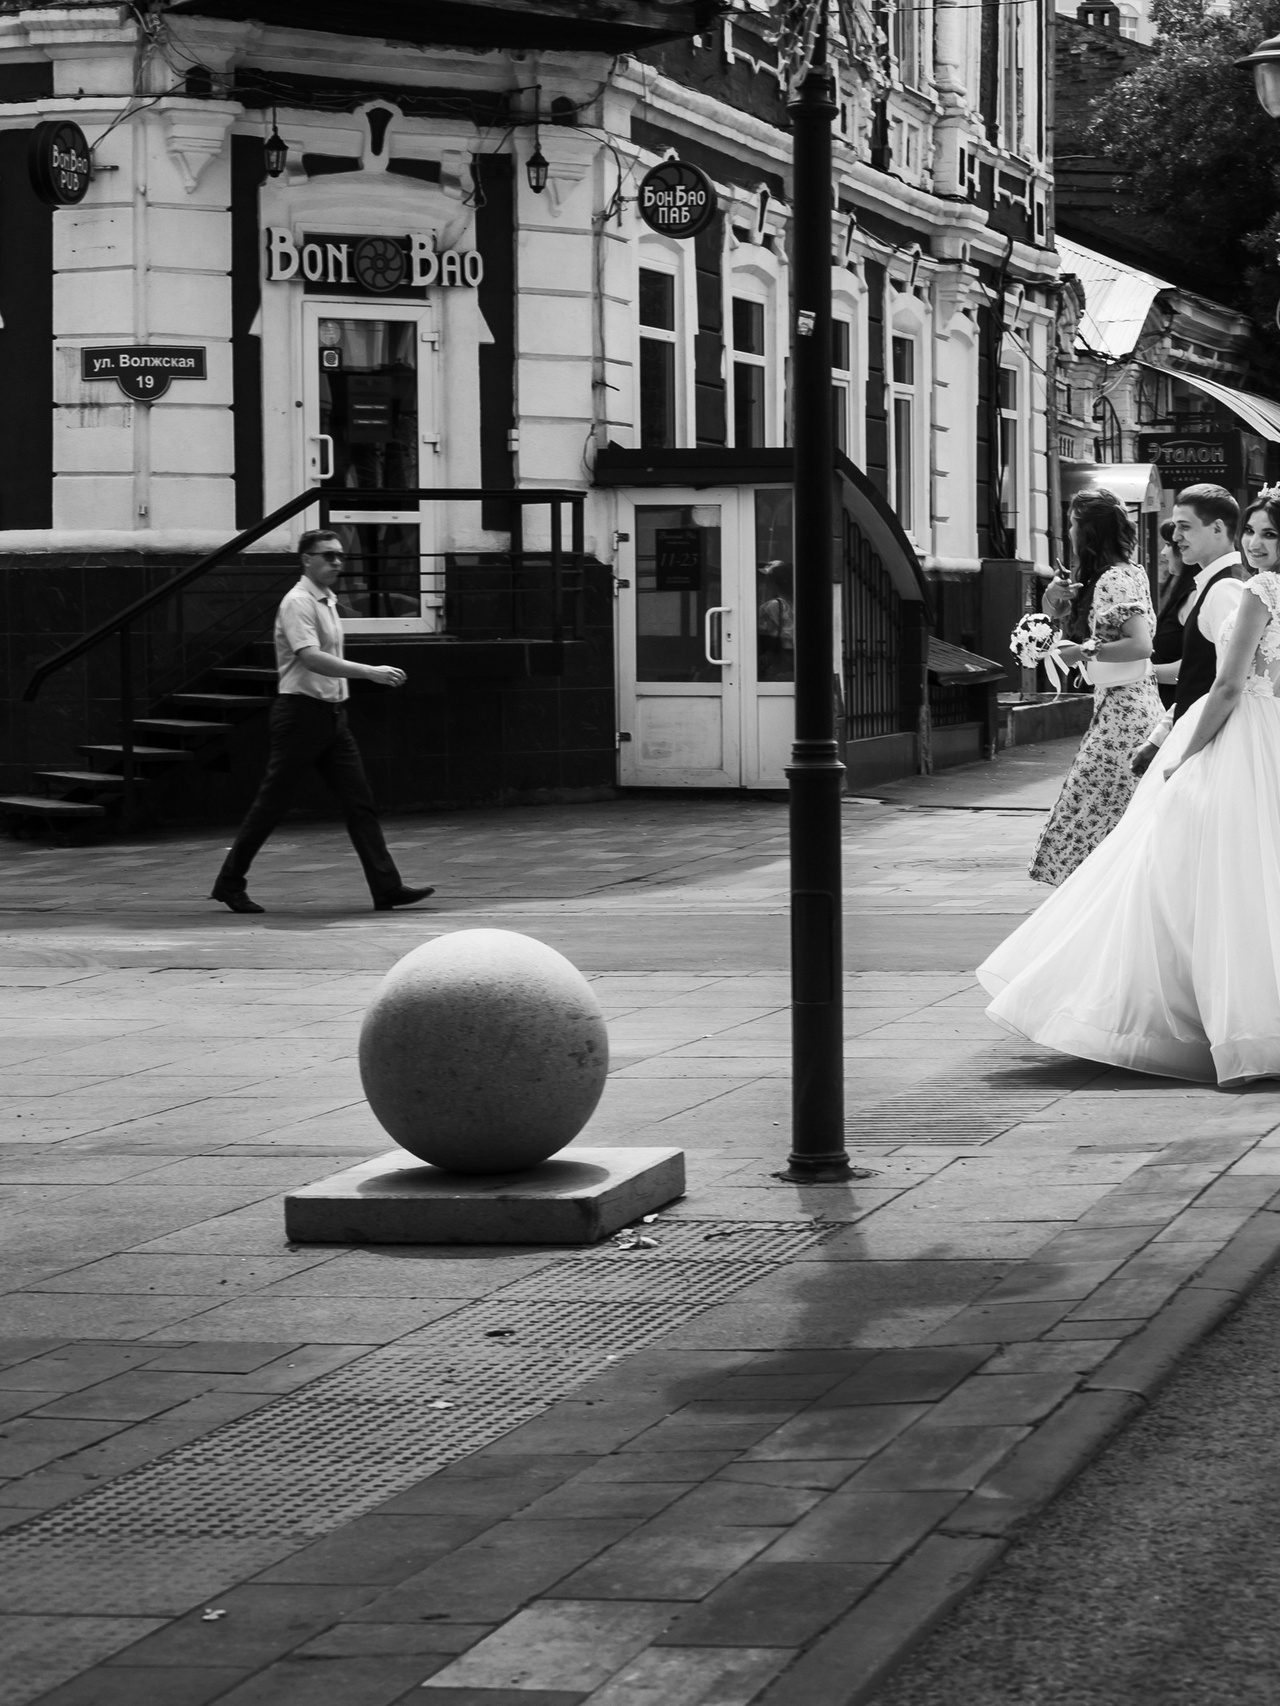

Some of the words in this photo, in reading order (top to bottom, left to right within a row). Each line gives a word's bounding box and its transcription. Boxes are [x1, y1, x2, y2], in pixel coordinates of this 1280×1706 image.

[60, 170, 80, 191] PUB
[658, 206, 691, 224] ПАБ
[93, 357, 115, 372] ул.
[119, 354, 195, 367] Волжская
[136, 375, 155, 389] 19
